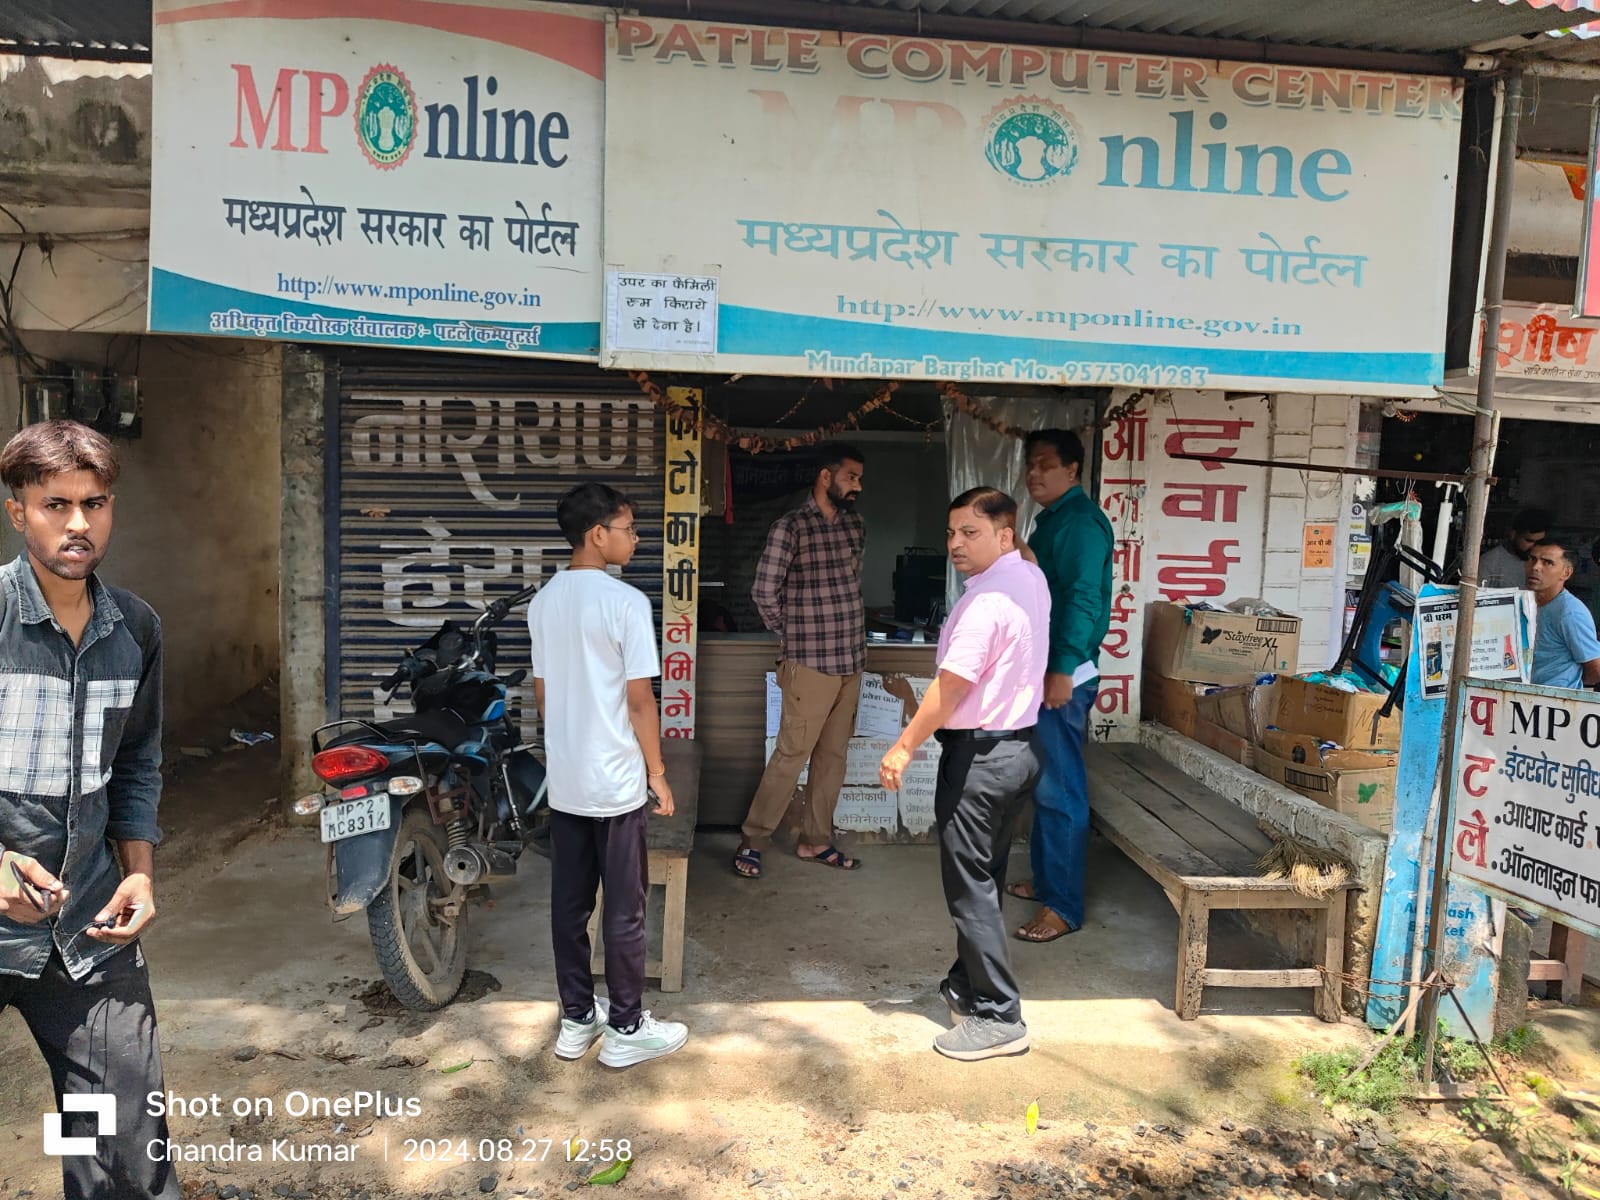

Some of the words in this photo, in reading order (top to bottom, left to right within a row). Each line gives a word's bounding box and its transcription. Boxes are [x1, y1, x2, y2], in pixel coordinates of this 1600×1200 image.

[616, 19, 821, 74] PATLE
[846, 37, 1209, 100] COMPUTER
[1231, 65, 1462, 120] CENTER
[222, 185, 347, 248] मध्यप्रदेश
[357, 207, 448, 250] सरकार
[458, 213, 494, 252] का
[504, 200, 580, 257] पोर्टल
[736, 209, 960, 270] मध्यप्रदेश
[979, 232, 1139, 277] सरकार
[1158, 242, 1220, 280] का
[1238, 231, 1369, 289] पोर्टल
[277, 272, 542, 310] http://www.mponline.gov.in
[650, 279, 668, 289] का
[672, 276, 717, 292] फैमिली
[211, 310, 279, 337] अधिकृत
[282, 312, 348, 335] कियोस्क
[434, 321, 473, 342] पटले
[632, 316, 647, 330] से
[651, 316, 679, 332] देना
[837, 294, 1302, 339] http://www.mponline.gov.in
[805, 351, 916, 377] Mundapar
[922, 356, 1005, 380] Barghat
[349, 391, 660, 511] नारायण
[1508, 700, 1571, 742] MP
[1504, 745, 1561, 789] इंटरनेट
[1502, 800, 1554, 837] आधार
[1554, 810, 1588, 849] कार्ड
[1499, 844, 1578, 900] ऑनलाइन
